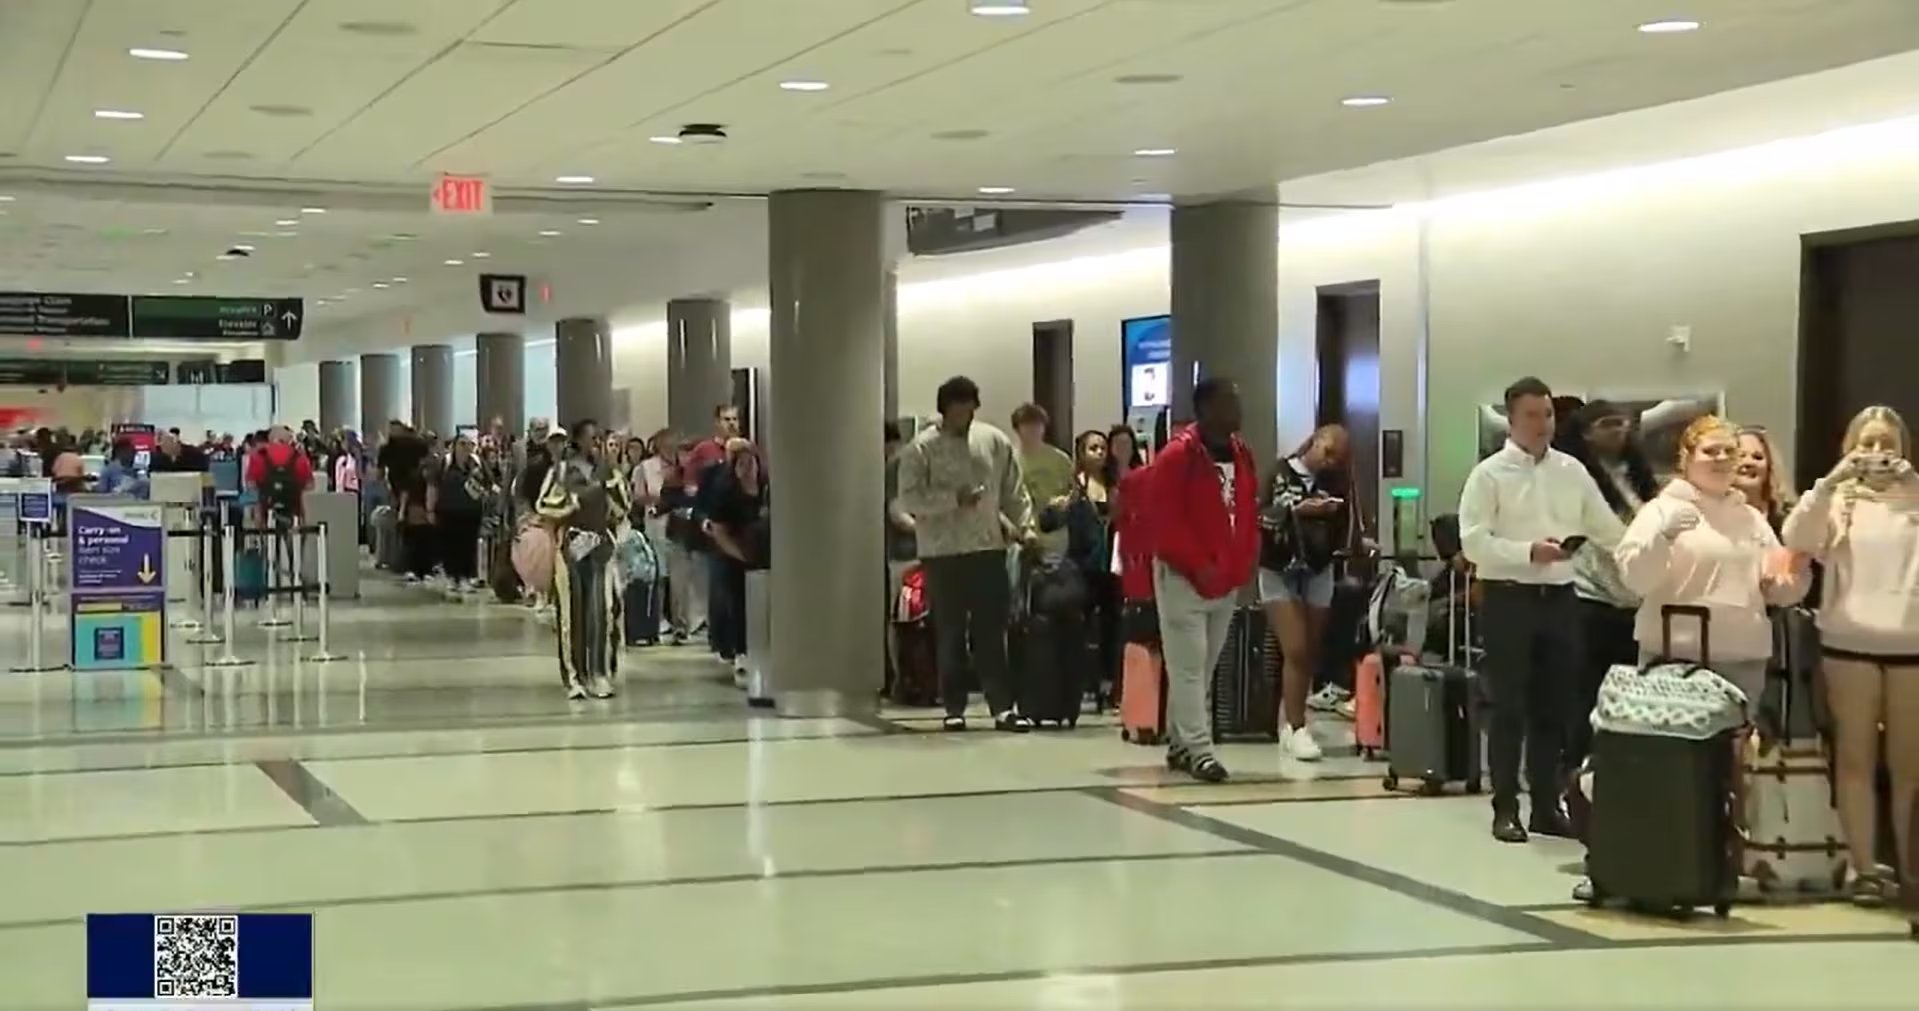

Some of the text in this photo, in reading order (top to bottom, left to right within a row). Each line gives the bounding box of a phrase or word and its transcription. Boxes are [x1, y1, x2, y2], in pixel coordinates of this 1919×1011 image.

[443, 180, 483, 210] EXIT
[263, 303, 273, 316] P
[87, 534, 129, 546] personal
